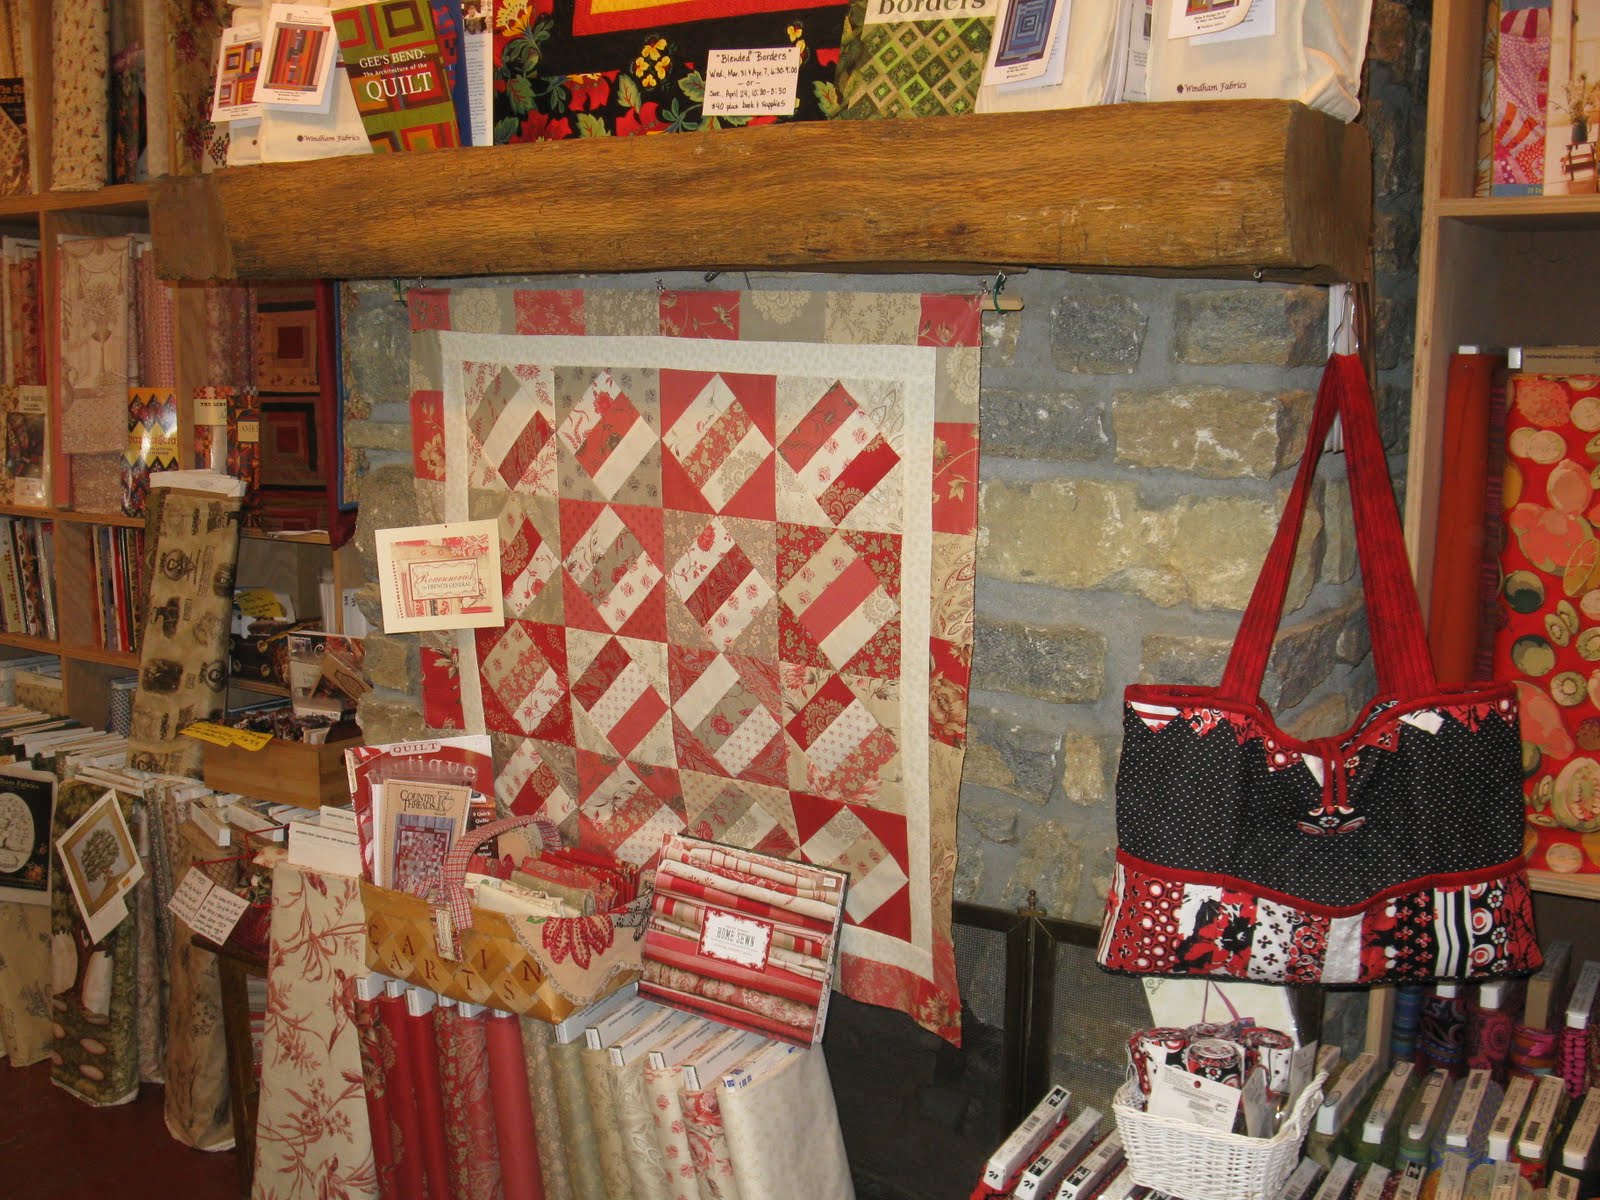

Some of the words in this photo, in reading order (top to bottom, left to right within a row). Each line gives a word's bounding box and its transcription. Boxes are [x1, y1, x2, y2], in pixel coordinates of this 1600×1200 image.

[359, 54, 390, 68] GEE'S
[391, 49, 426, 63] BEND:
[374, 65, 408, 76] Architecture
[366, 71, 432, 102] QUILT
[1184, 82, 1218, 92] Windham
[1219, 80, 1247, 92] Fabrics
[762, 101, 786, 112] supplies
[336, 134, 360, 142] Fabrics
[427, 582, 448, 590] FRENCH
[448, 580, 471, 589] GENERAL
[393, 742, 438, 754] QUILT
[400, 790, 436, 804] COUNTRY
[717, 927, 734, 941] HOME
[736, 932, 756, 947] SEWN
